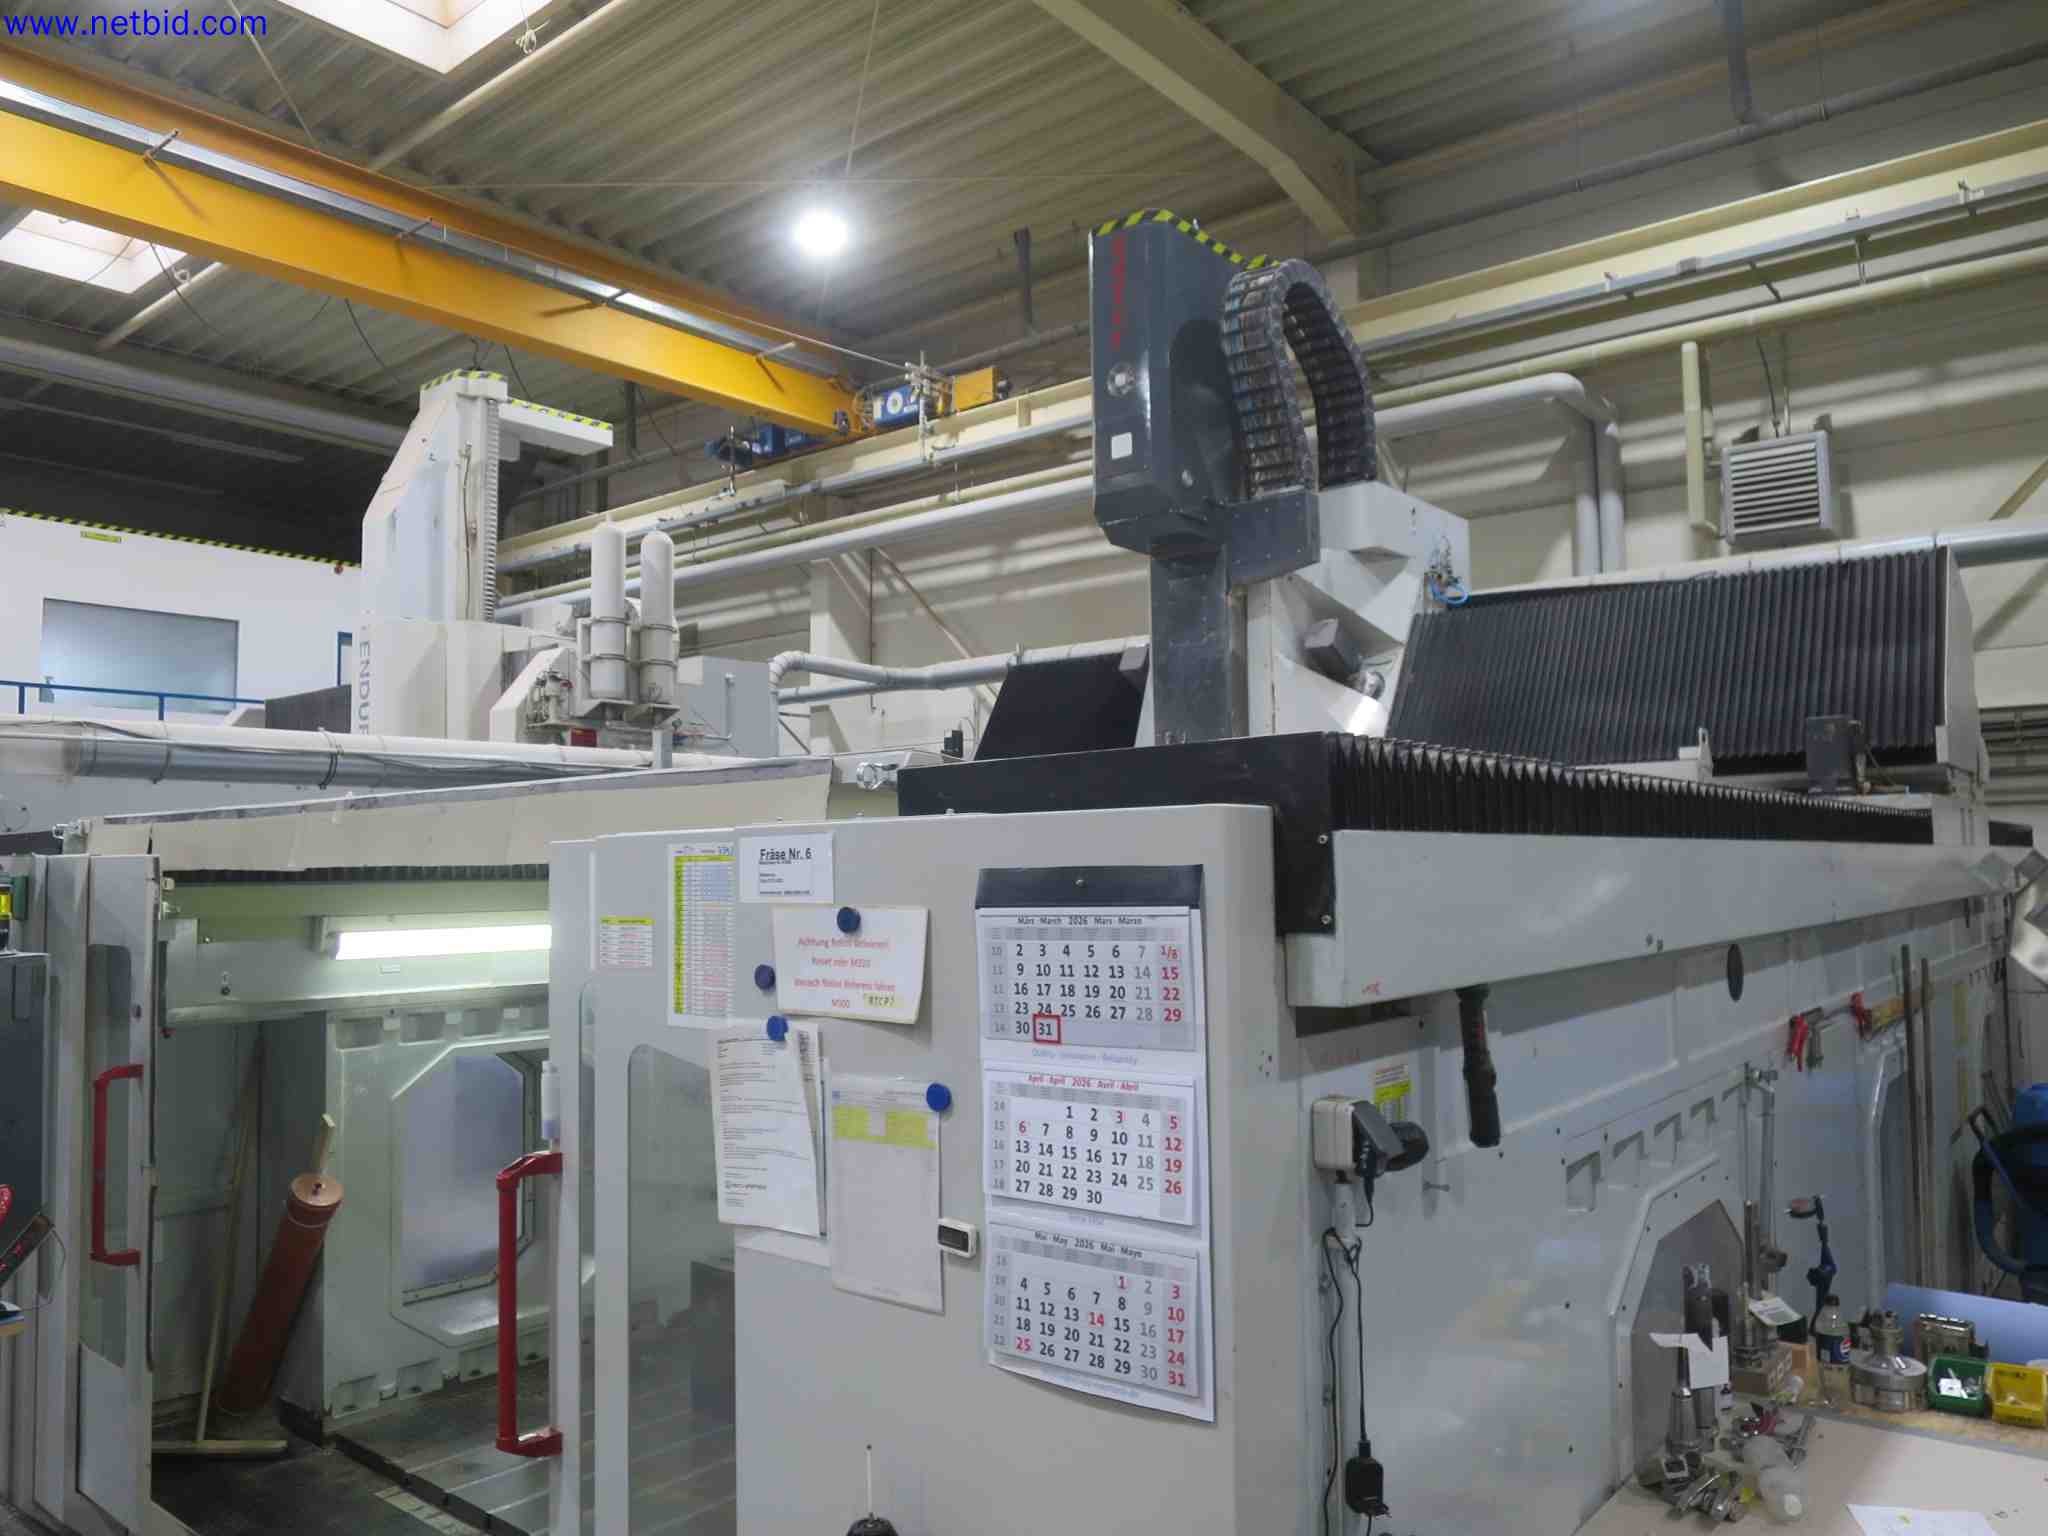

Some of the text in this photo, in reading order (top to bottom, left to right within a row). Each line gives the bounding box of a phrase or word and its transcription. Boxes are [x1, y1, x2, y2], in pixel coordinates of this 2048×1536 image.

[760, 847, 812, 860] Fräse Nr. 6
[1017, 944, 1023, 956] 2
[1040, 944, 1048, 956] 3
[1063, 945, 1070, 956] 4
[1088, 945, 1095, 958] 5
[1112, 945, 1120, 958] 6
[1138, 945, 1146, 959] 7
[1160, 946, 1177, 961] 1/8
[1017, 963, 1024, 976] 9
[1036, 964, 1051, 976] 10
[1060, 965, 1074, 977] 11
[1084, 965, 1099, 978] 12
[1109, 965, 1124, 979] 13
[1135, 966, 1150, 979] 14
[1162, 967, 1178, 980] 15
[1014, 983, 1028, 995] 16
[1037, 984, 1051, 996] 17
[1060, 984, 1075, 997] 18
[1085, 985, 1100, 998] 19
[1110, 985, 1125, 999] 20
[1136, 986, 1152, 1000] 21
[1163, 987, 1180, 1000] 22
[1016, 1002, 1029, 1015] 23
[1038, 1004, 1051, 1015] 24
[1061, 1005, 1075, 1017] 25
[1086, 1005, 1100, 1018] 26
[1110, 1006, 1126, 1019] 27
[1136, 1008, 1152, 1021] 28
[1164, 1008, 1181, 1022] 29
[1016, 1021, 1030, 1034] 30
[1039, 1022, 1052, 1036] 31
[1067, 1106, 1073, 1118] 1
[1091, 1108, 1097, 1121] 2
[1116, 1111, 1123, 1124] 3
[1142, 1113, 1150, 1127] 4
[1170, 1116, 1177, 1129] 5
[1019, 1121, 1026, 1133] 6
[1043, 1123, 1049, 1136] 7
[1066, 1126, 1073, 1139] 8
[1090, 1129, 1098, 1142] 9
[1112, 1131, 1128, 1145] 10
[1138, 1134, 1154, 1148] 11
[1165, 1137, 1182, 1152] 12
[1016, 1140, 1030, 1153] 13
[1039, 1143, 1053, 1157] 14
[1062, 1145, 1077, 1160] 15
[1087, 1149, 1101, 1163] 16
[1112, 1152, 1127, 1165] 17
[1137, 1155, 1154, 1169] 18
[1165, 1158, 1182, 1173] 19
[1016, 1160, 1030, 1173] 20
[1039, 1163, 1053, 1176] 21
[1062, 1166, 1076, 1180] 22
[1087, 1169, 1101, 1184] 23
[1112, 1173, 1127, 1187] 24
[1137, 1176, 1154, 1191] 25
[1165, 1179, 1182, 1194] 26
[1016, 1179, 1030, 1192] 27
[1039, 1182, 1053, 1197] 28
[1062, 1186, 1077, 1200] 29
[1087, 1190, 1102, 1204] 30
[1118, 1276, 1126, 1290] 1
[1144, 1280, 1152, 1294] 2
[1173, 1285, 1180, 1299] 3
[1021, 1278, 1027, 1290] 4
[1044, 1282, 1050, 1295] 5
[1068, 1288, 1075, 1300] 6
[1093, 1291, 1100, 1304] 7
[1118, 1296, 1126, 1311] 8
[1144, 1302, 1152, 1315] 9
[1168, 1307, 1184, 1322] 10
[1016, 1297, 1030, 1312] 11
[1040, 1302, 1055, 1316] 12
[1064, 1307, 1079, 1322] 13
[1090, 1312, 1104, 1326] 14
[1114, 1317, 1130, 1332] 15
[1140, 1322, 1157, 1338] 16
[1168, 1328, 1184, 1343] 17
[1016, 1317, 1031, 1331] 18
[1040, 1322, 1055, 1336] 19
[1064, 1327, 1079, 1342] 20
[1089, 1332, 1104, 1348] 21
[1114, 1338, 1130, 1353] 22
[1140, 1344, 1156, 1359] 23
[1168, 1350, 1184, 1365] 24
[1016, 1337, 1032, 1351] 25
[1040, 1342, 1055, 1357] 26
[1064, 1347, 1079, 1362] 27
[1089, 1353, 1104, 1368] 28
[1115, 1359, 1131, 1374] 29
[1141, 1365, 1158, 1381] 30
[1169, 1371, 1185, 1387] 31
